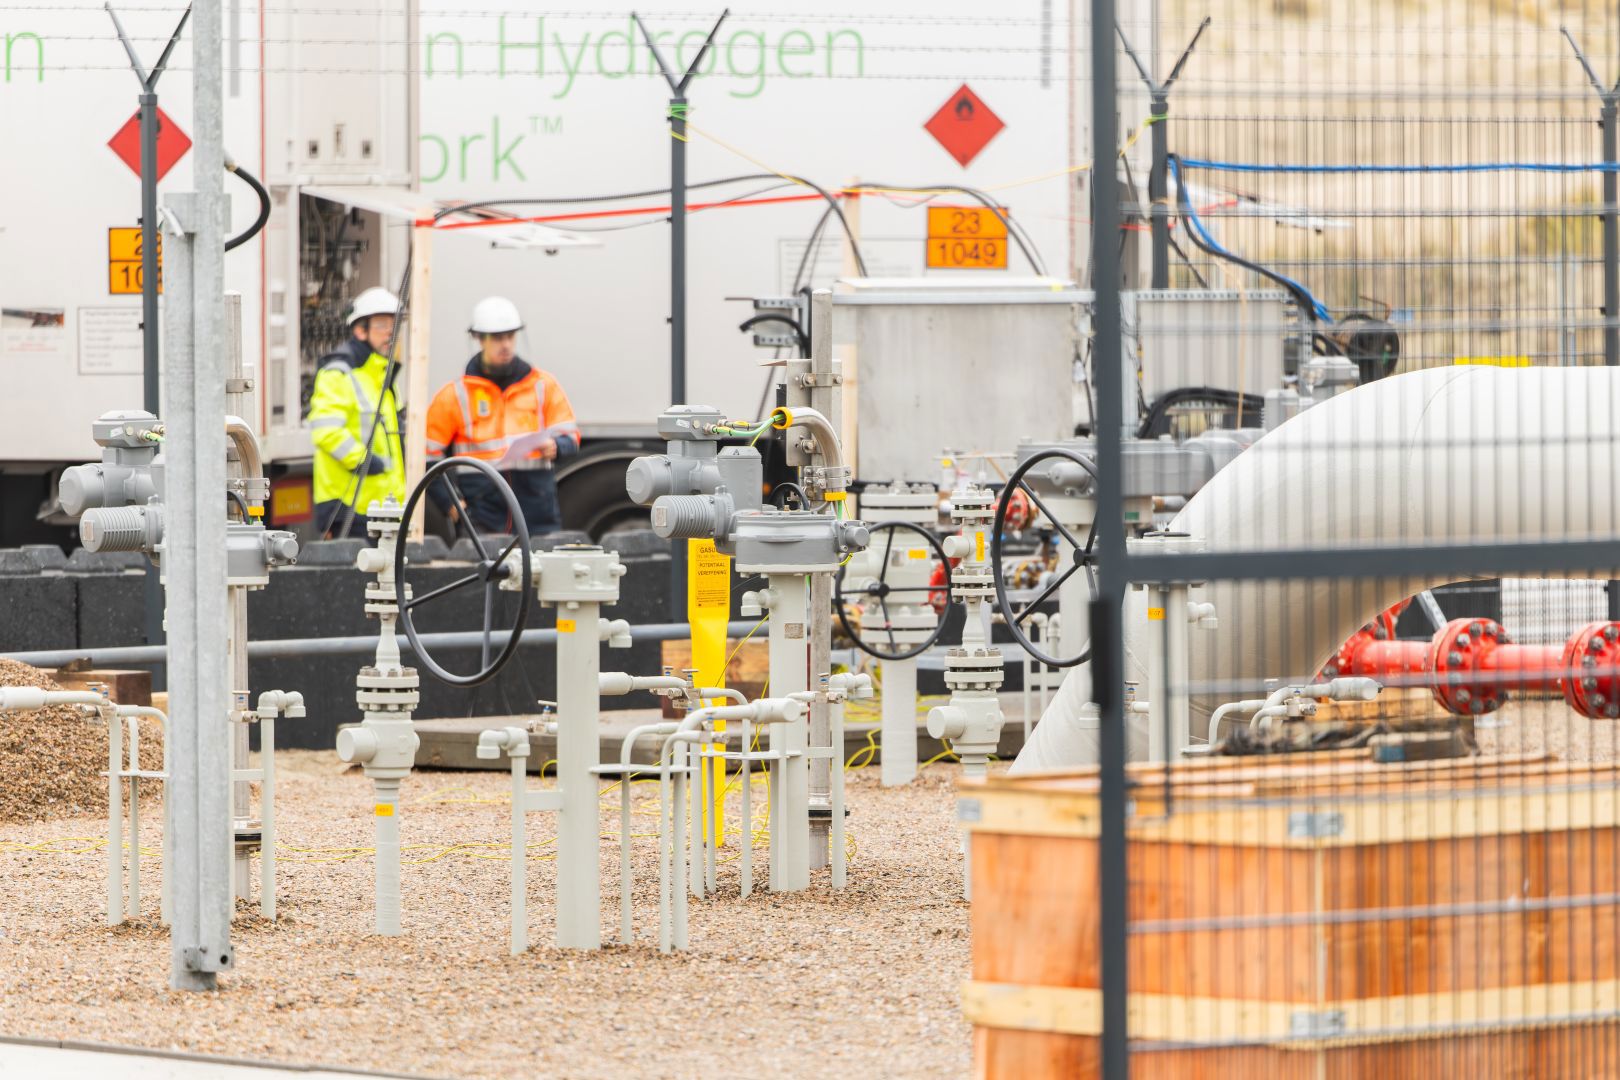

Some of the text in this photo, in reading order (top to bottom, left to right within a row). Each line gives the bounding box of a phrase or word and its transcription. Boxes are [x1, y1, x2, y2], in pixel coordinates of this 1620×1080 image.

[498, 15, 866, 100] Hydrogen
[952, 211, 980, 234] 23
[939, 242, 997, 265] 1049
